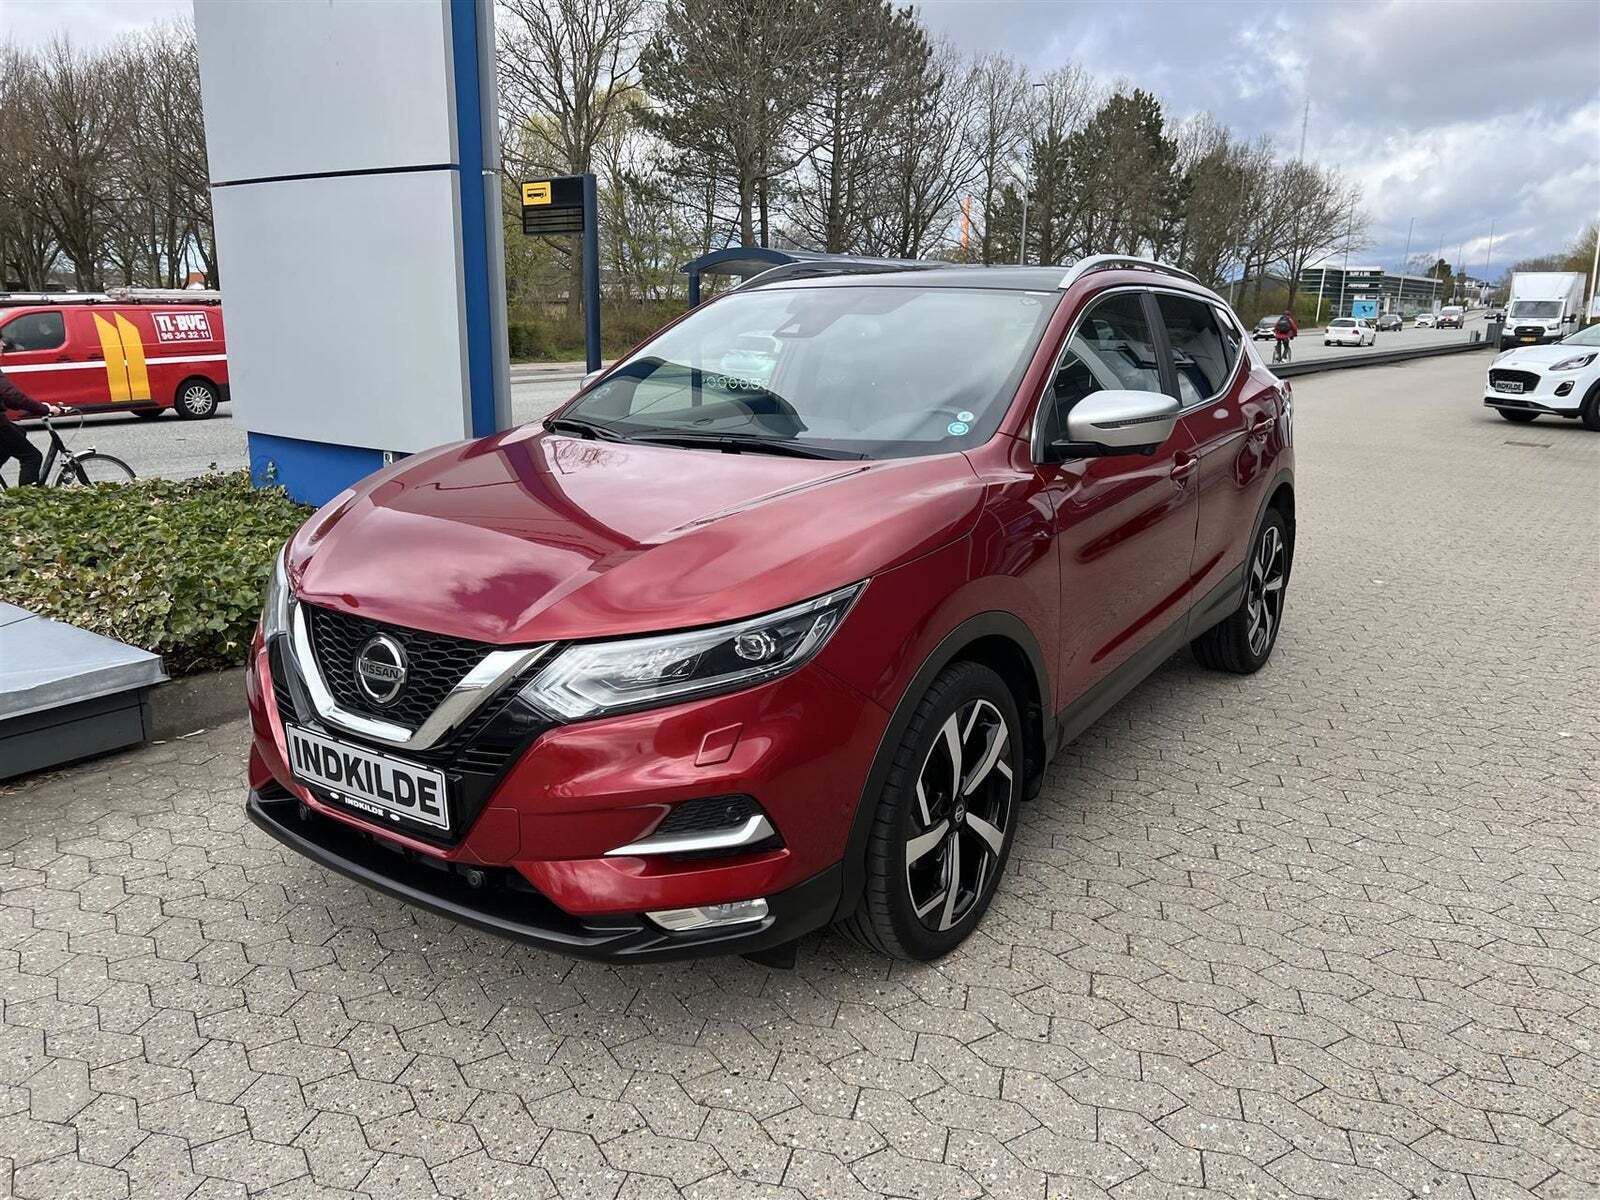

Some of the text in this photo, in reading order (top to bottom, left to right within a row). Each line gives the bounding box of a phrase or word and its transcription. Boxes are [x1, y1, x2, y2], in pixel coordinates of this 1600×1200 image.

[361, 660, 399, 679] NISSAN
[293, 735, 441, 817] INDKILDE
[344, 796, 384, 817] INDKILDE
